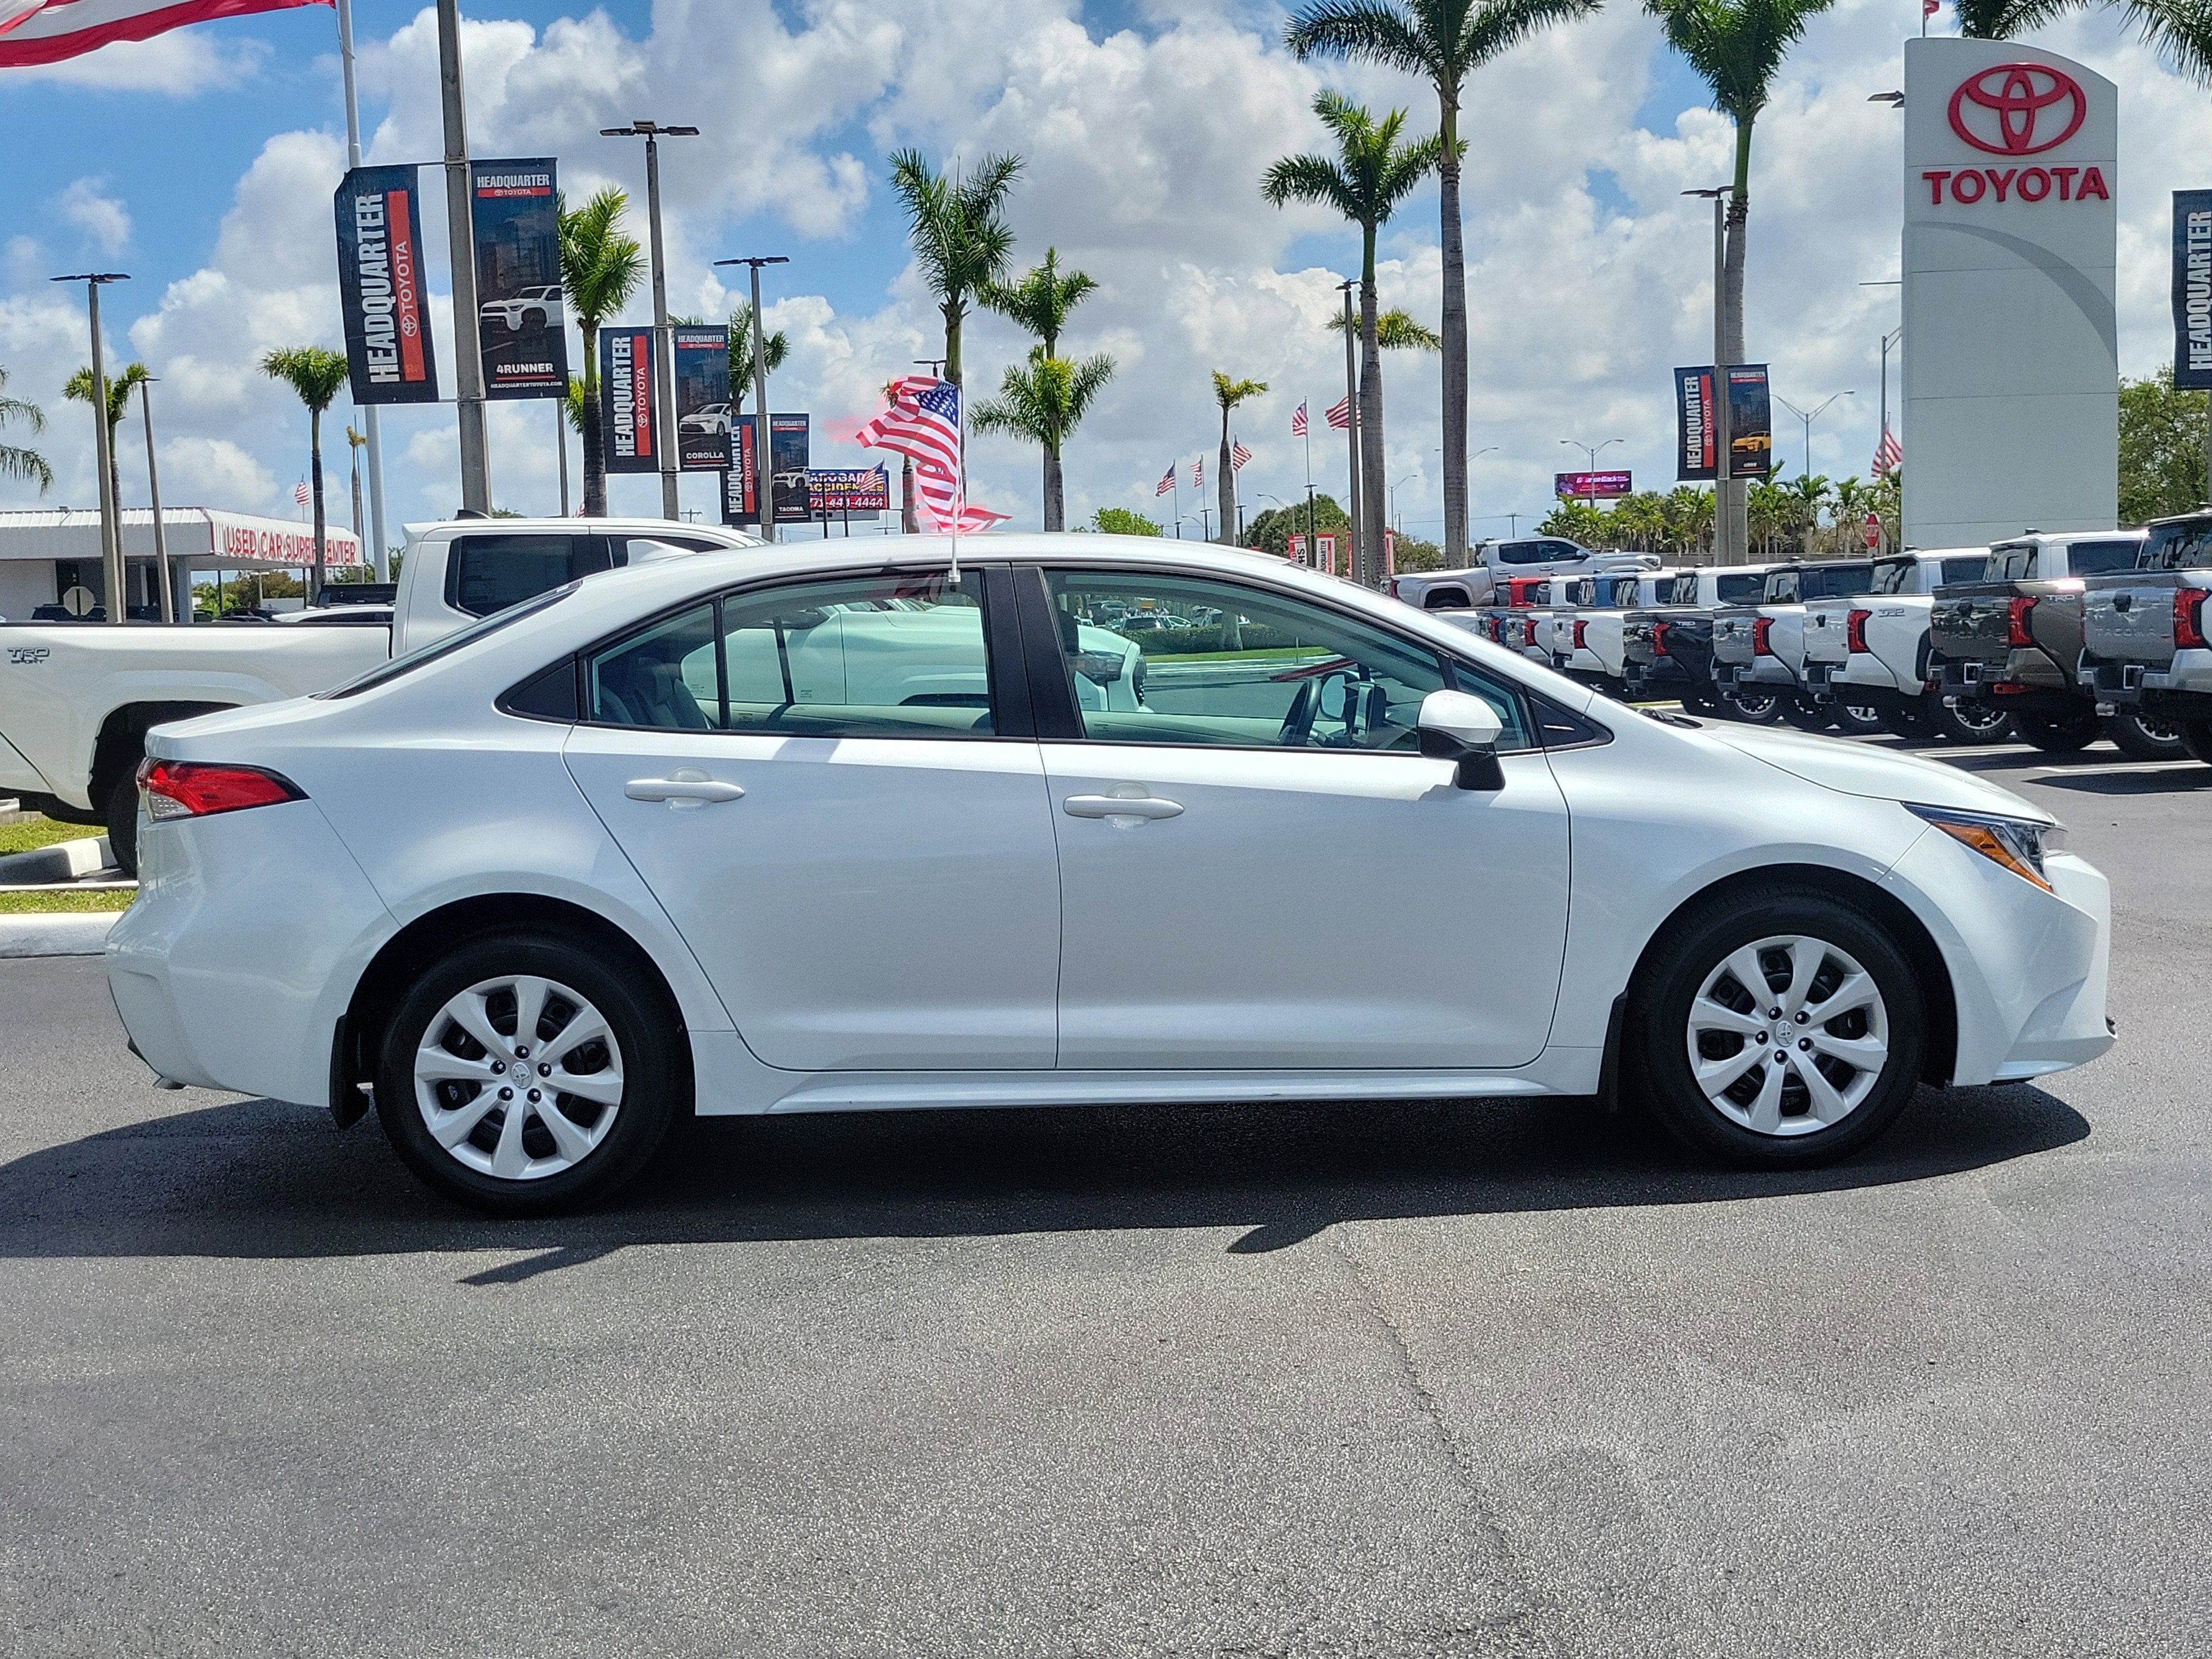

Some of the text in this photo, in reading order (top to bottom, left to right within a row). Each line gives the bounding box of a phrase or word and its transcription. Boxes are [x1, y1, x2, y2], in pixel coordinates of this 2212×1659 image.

[477, 174, 550, 188] HEADQUARTER
[1922, 167, 2110, 205] TOYOTA
[355, 193, 400, 383] HEADQUARTER
[396, 241, 414, 313] TOYOTA
[2186, 211, 2212, 370] HEADQUARTER
[678, 335, 724, 343] HEADQUARTER
[496, 363, 554, 374] 4RUNNER
[612, 336, 635, 456] HEADQUARTER
[637, 367, 647, 413] TOYOTA
[1684, 376, 1703, 469] HEADQUARTER
[1703, 399, 1713, 436] TOYOTA
[744, 448, 752, 481] TOYOTA
[227, 526, 257, 555] USED
[261, 531, 283, 558] CAR
[325, 539, 356, 565] ENTER
[7, 647, 50, 661] TRD
